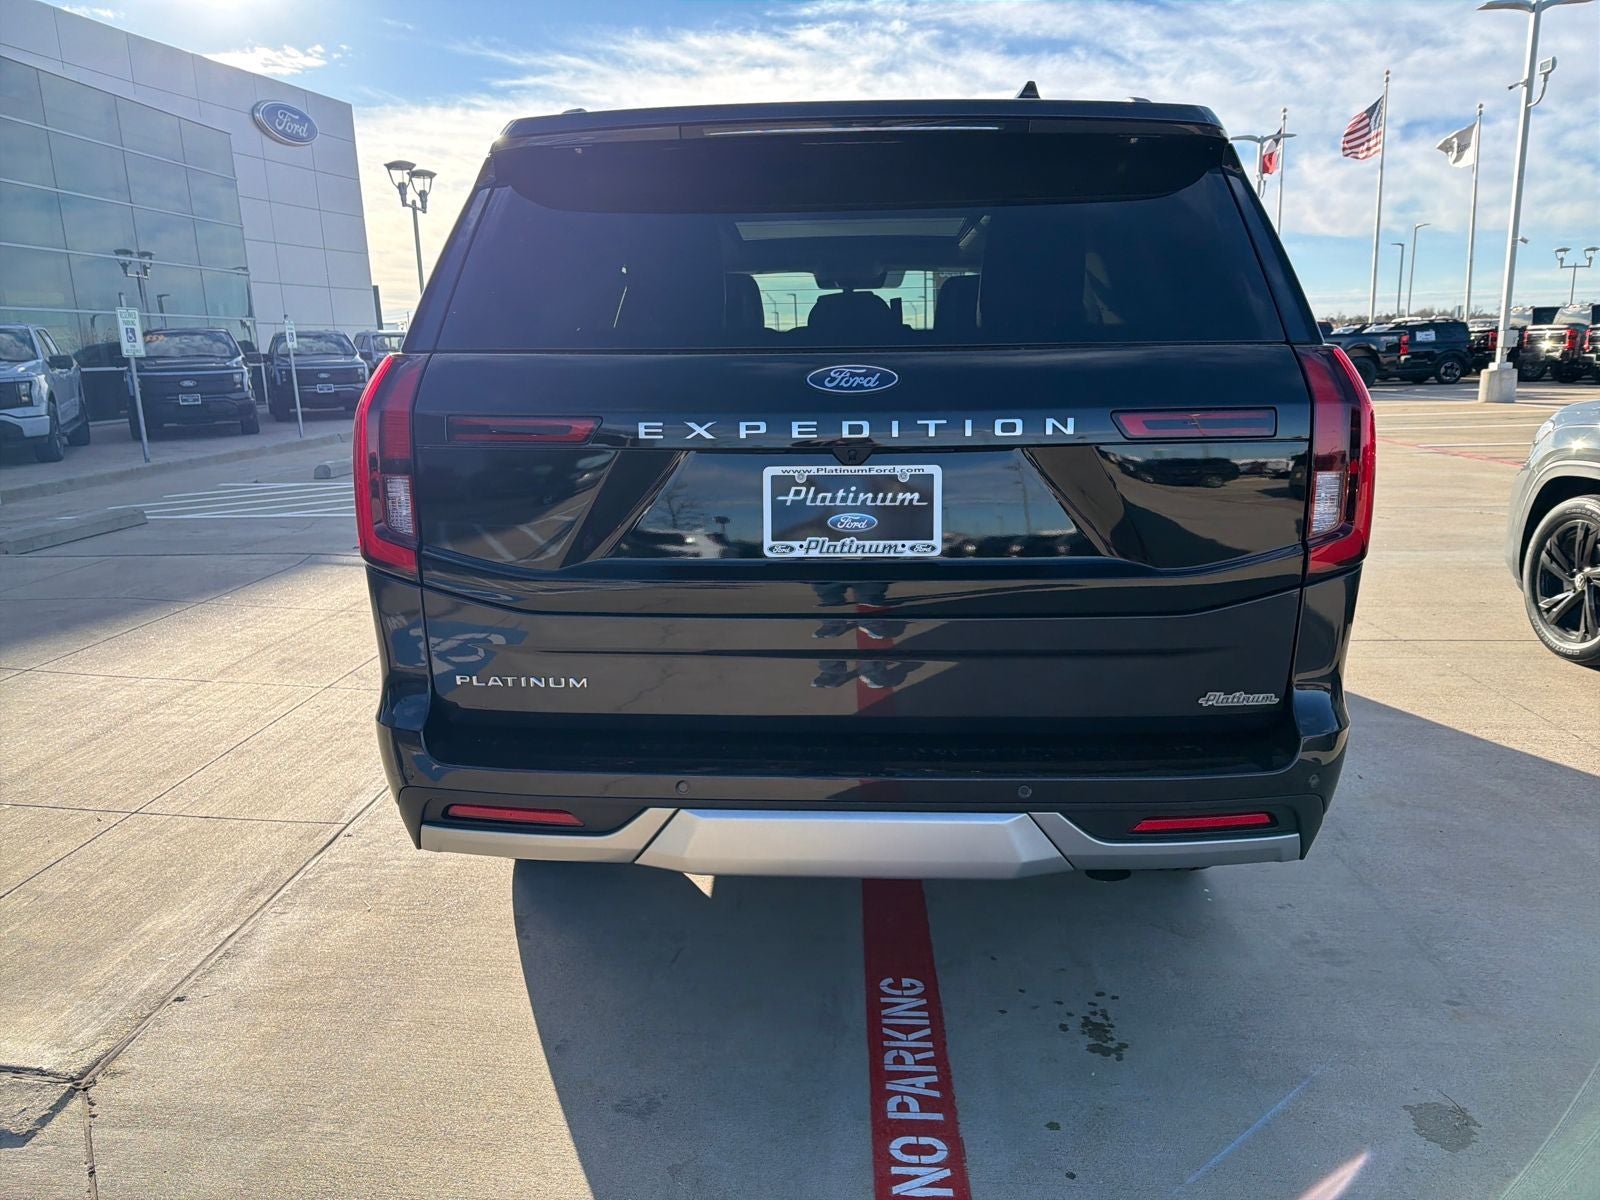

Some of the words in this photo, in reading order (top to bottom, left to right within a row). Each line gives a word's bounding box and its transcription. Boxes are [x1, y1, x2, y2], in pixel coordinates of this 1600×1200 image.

[275, 109, 308, 137] Ford
[824, 368, 880, 387] Ford
[637, 417, 1076, 440] EXPEDITION
[781, 466, 925, 475] www.PlatinumFord.com
[776, 486, 928, 506] Platinum
[837, 514, 868, 529] Ford
[804, 537, 906, 555] Platinum
[913, 545, 932, 553] Ford
[455, 675, 588, 688] PLATINUM
[1198, 691, 1279, 706] Platinum
[879, 977, 944, 1121] PARKING
[889, 1136, 953, 1196] NO
